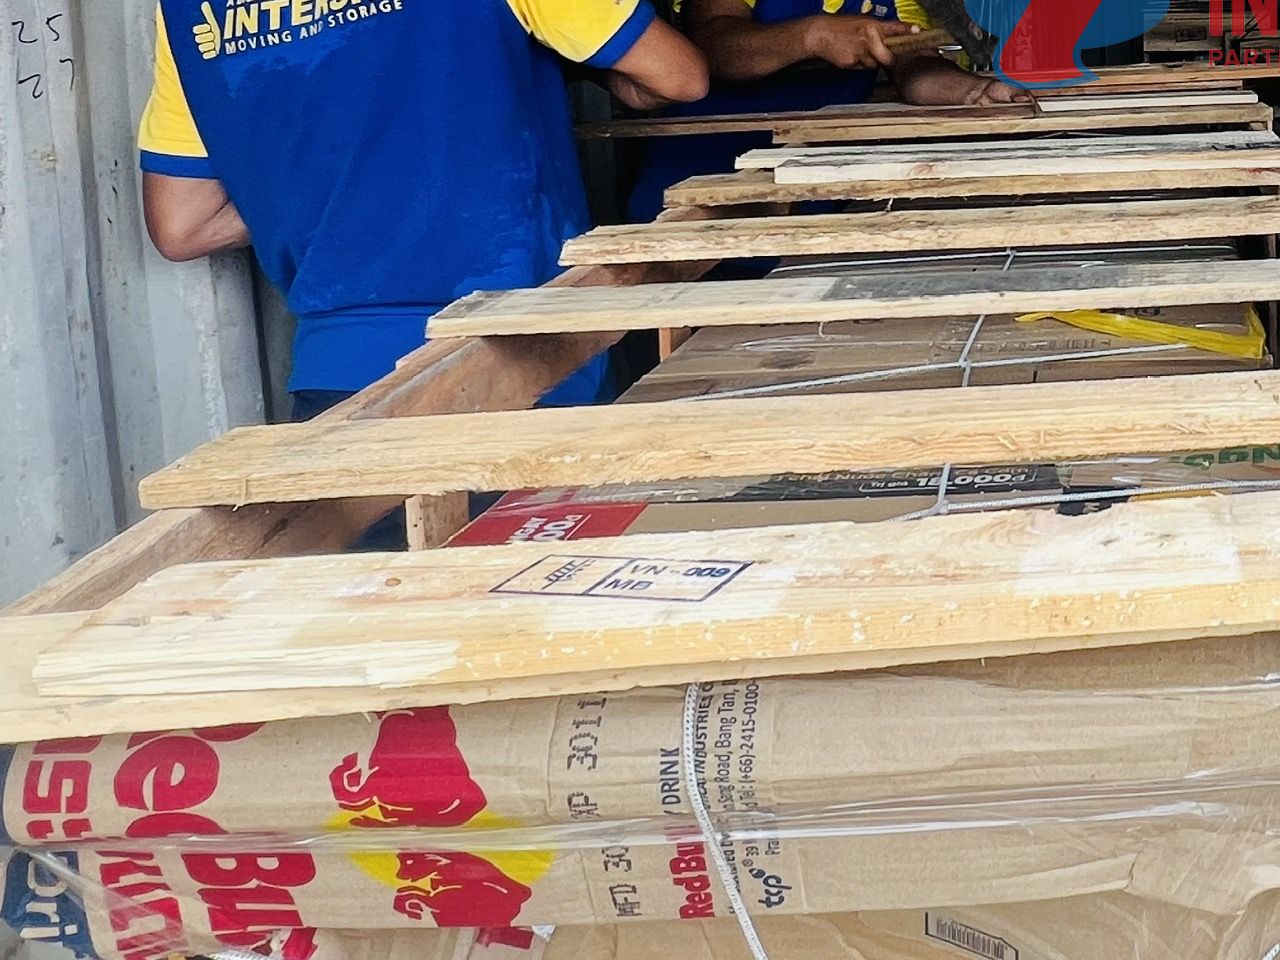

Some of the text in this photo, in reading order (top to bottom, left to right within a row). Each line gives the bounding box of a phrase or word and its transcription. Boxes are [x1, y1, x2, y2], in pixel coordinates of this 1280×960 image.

[224, 29, 293, 55] MOVING
[718, 689, 737, 712] Tan,
[717, 717, 738, 748] Bang
[659, 747, 681, 805] DRINK
[714, 751, 734, 783] Road,
[745, 845, 758, 857] 39
[674, 876, 715, 919] Red
